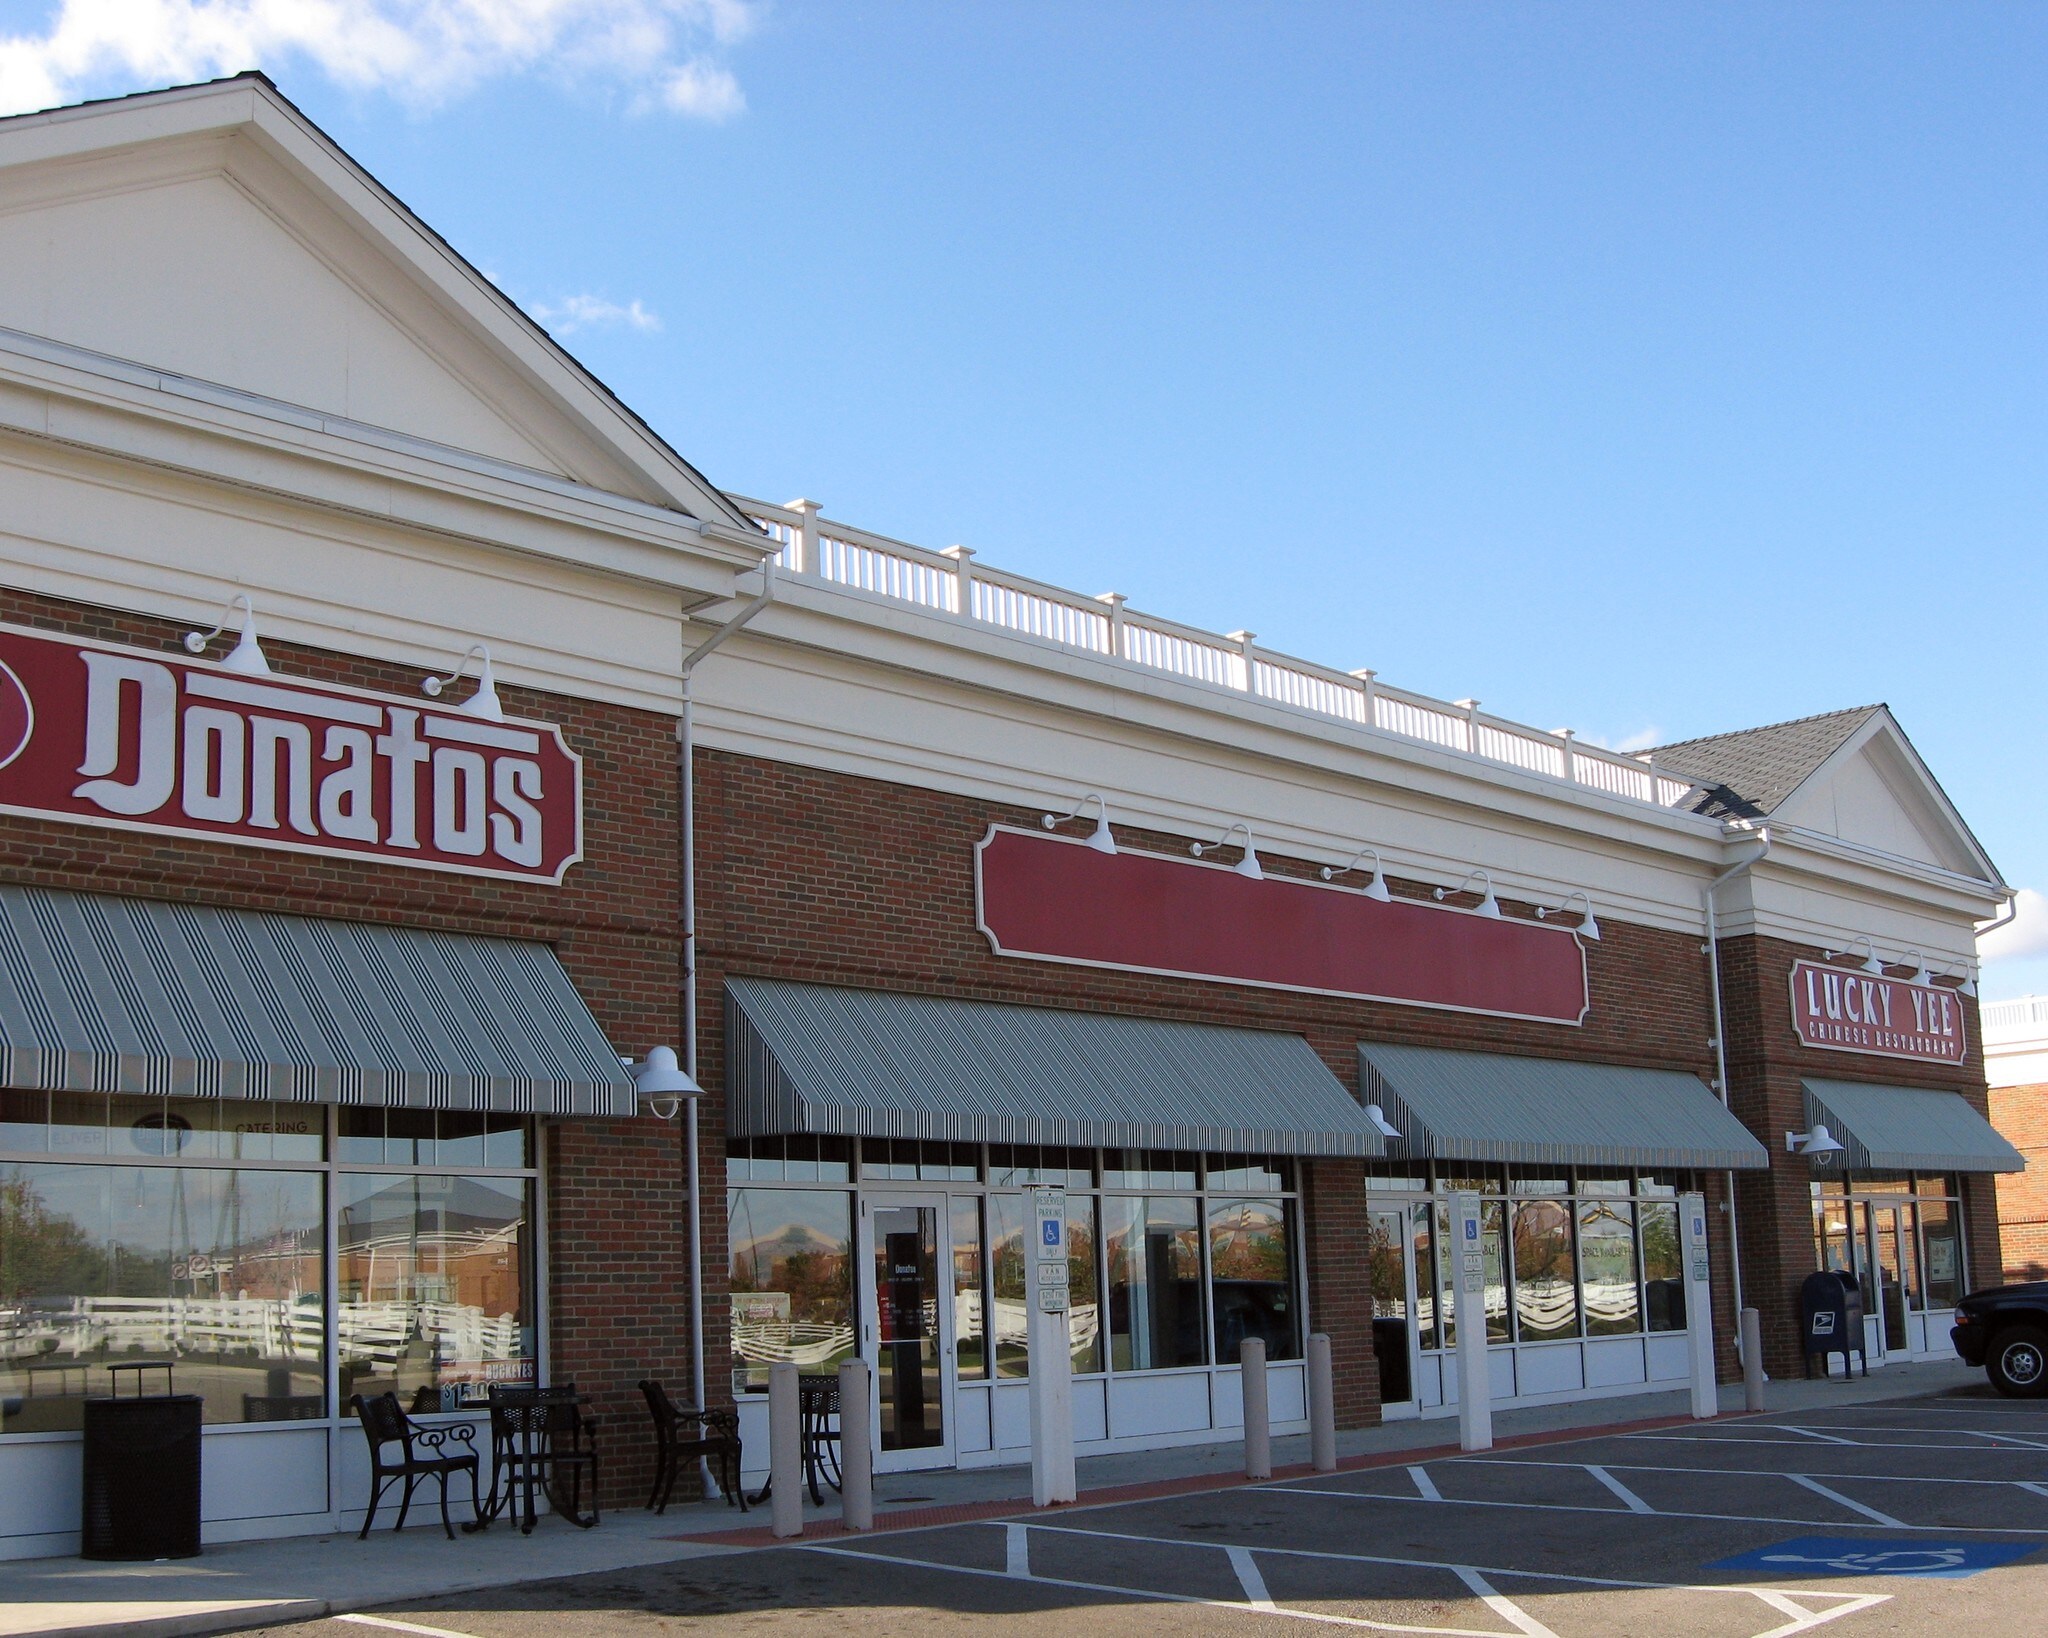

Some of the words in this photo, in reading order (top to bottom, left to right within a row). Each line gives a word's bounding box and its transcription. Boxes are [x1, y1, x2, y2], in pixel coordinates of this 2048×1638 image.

[73, 650, 546, 868] Donatos
[1805, 970, 1892, 1028] LUCKY
[1910, 988, 1954, 1037] YEE
[1808, 1021, 1868, 1046] CHINESE
[1875, 1031, 1955, 1057] RESTAURANT
[236, 1120, 308, 1136] CATERING
[1036, 1195, 1064, 1206] RESERVED
[1038, 1208, 1063, 1218] PARKING
[486, 1363, 534, 1380] BUCKEYES
